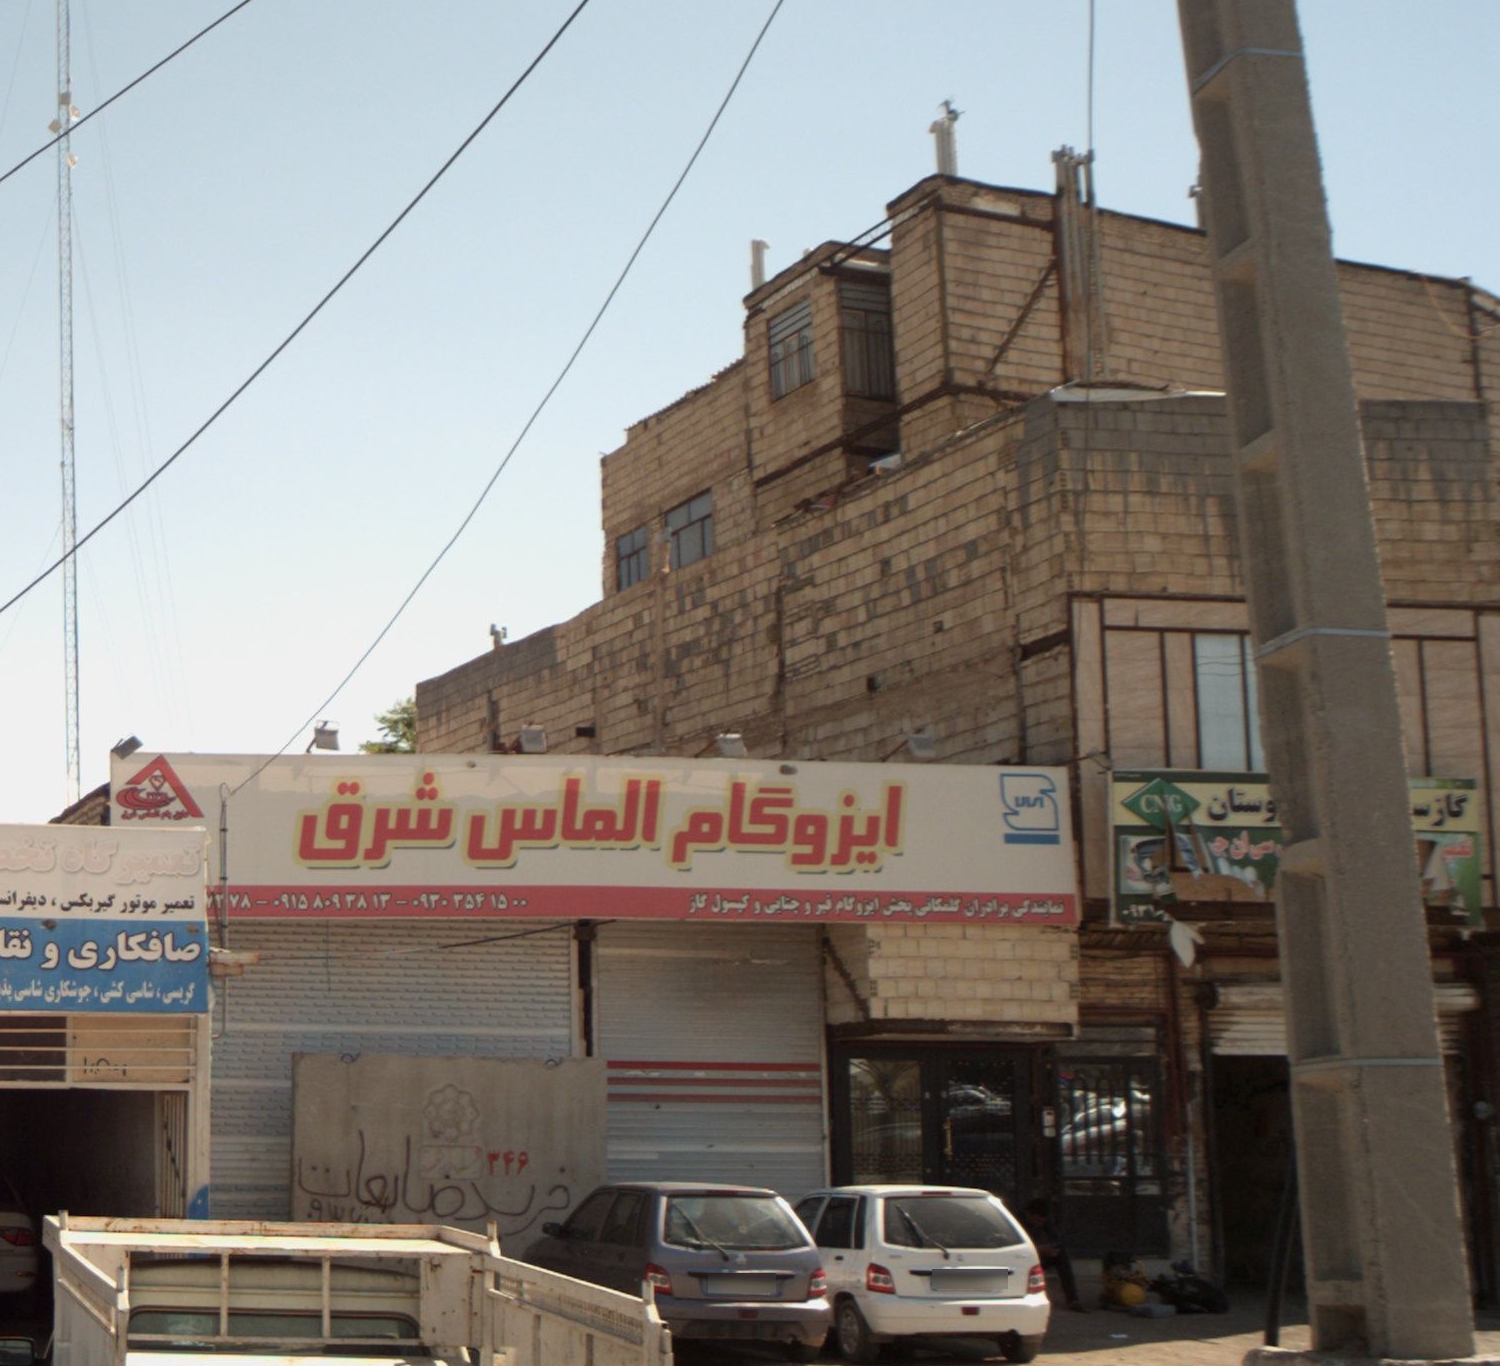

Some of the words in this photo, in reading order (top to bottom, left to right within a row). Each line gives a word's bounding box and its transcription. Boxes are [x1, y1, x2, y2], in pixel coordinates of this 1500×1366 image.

[299, 771, 454, 861] شرق
[467, 778, 662, 861] الماس
[1139, 794, 1183, 814] CNG
[671, 782, 903, 866] ایزوگام
[120, 894, 157, 915] موتور
[161, 894, 196, 915] تعمیر
[39, 937, 61, 970] و
[67, 930, 202, 972] صافکاری
[486, 1150, 529, 1177] ۳۴۶
